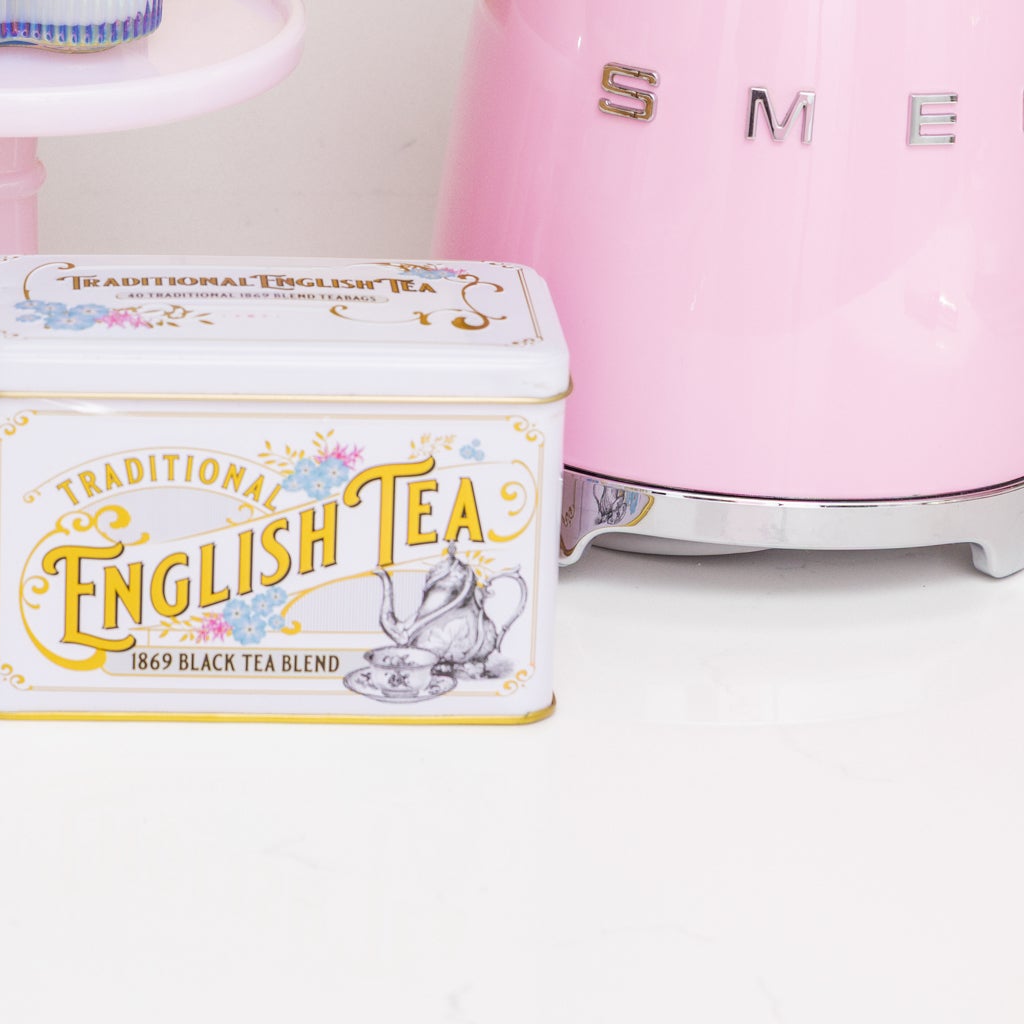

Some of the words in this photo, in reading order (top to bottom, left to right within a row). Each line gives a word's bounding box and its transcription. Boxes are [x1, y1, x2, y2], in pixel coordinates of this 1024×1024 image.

[597, 61, 1024, 147] SME
[56, 274, 253, 291] TRADITIONAL
[252, 274, 374, 291] ENGLISH
[374, 278, 437, 294] TEA
[320, 294, 377, 302] TEABAGS
[56, 454, 283, 512] TRADITIONAL
[42, 500, 339, 652] ENGLISH
[343, 456, 485, 567] TEA
[131, 652, 173, 671] 1869
[178, 653, 236, 672] BLACK
[242, 654, 276, 672] TEA
[281, 654, 341, 673] BLEND
